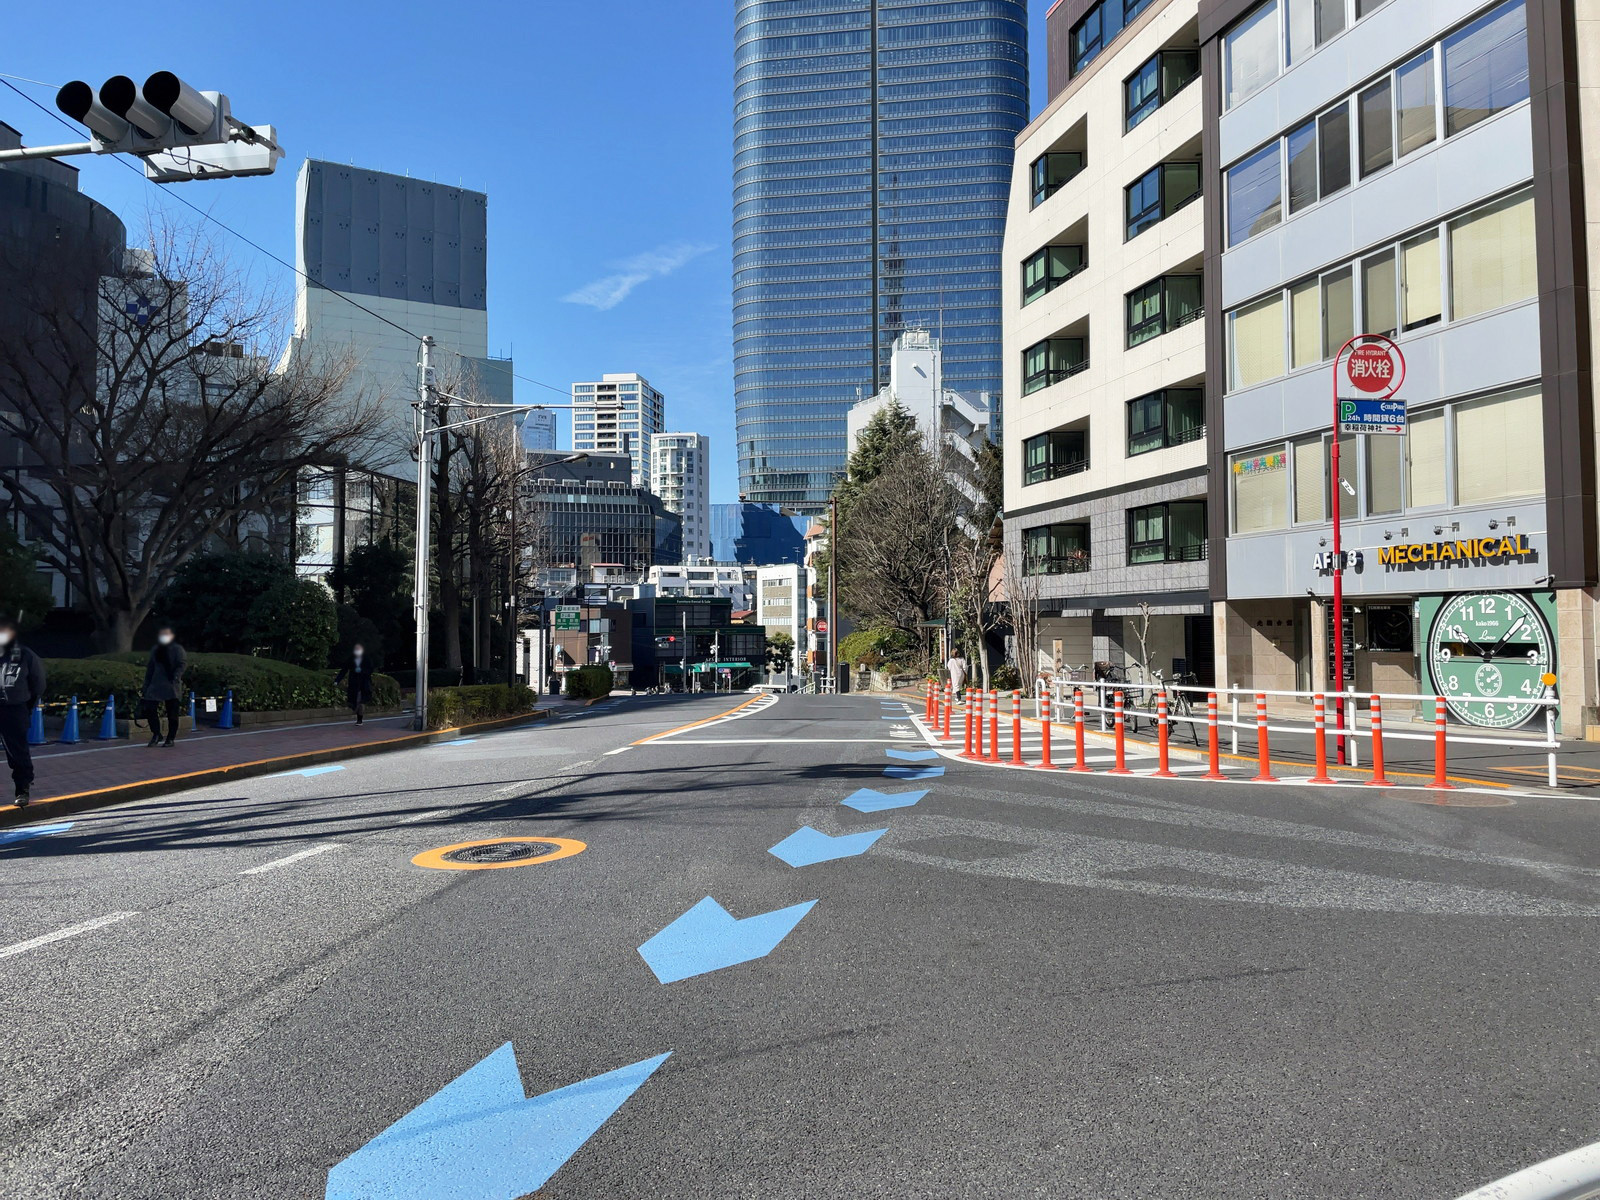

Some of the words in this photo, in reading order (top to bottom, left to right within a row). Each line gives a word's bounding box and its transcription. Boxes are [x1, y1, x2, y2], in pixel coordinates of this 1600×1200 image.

[1351, 358, 1391, 378] 消火栓
[1340, 401, 1356, 421] P
[1364, 414, 1404, 423] 時間貸6台
[1344, 424, 1382, 432] 幸稲荷神社
[1378, 534, 1530, 565] MECHANICAL
[1312, 551, 1340, 570] AF
[1460, 606, 1474, 620] 11
[1478, 598, 1496, 614] 12
[1505, 605, 1512, 620] 1
[1446, 625, 1462, 640] 10
[1521, 624, 1532, 640] 2
[1441, 648, 1451, 663] 9
[1526, 650, 1538, 666] 3
[1449, 676, 1458, 690] 8
[1521, 679, 1531, 694] 4
[1463, 693, 1472, 707] 7
[1485, 703, 1494, 718] 6
